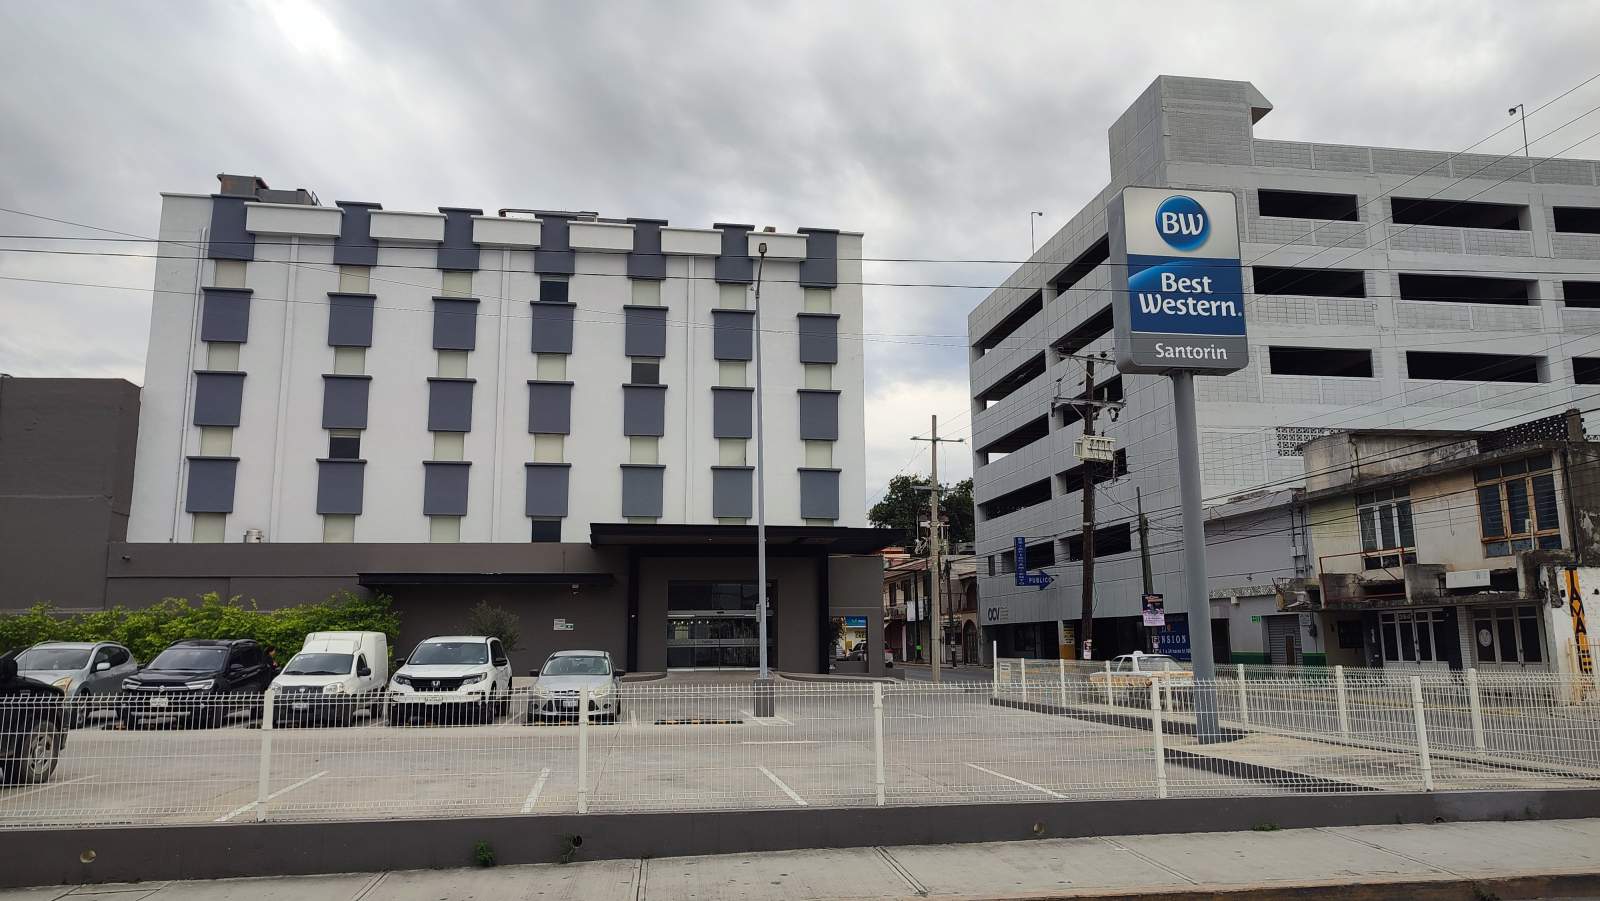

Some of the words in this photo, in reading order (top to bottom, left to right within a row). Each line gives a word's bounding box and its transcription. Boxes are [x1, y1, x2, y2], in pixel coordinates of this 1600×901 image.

[1162, 212, 1204, 236] BW
[1161, 272, 1213, 294] Best
[1155, 343, 1228, 360] Santorin
